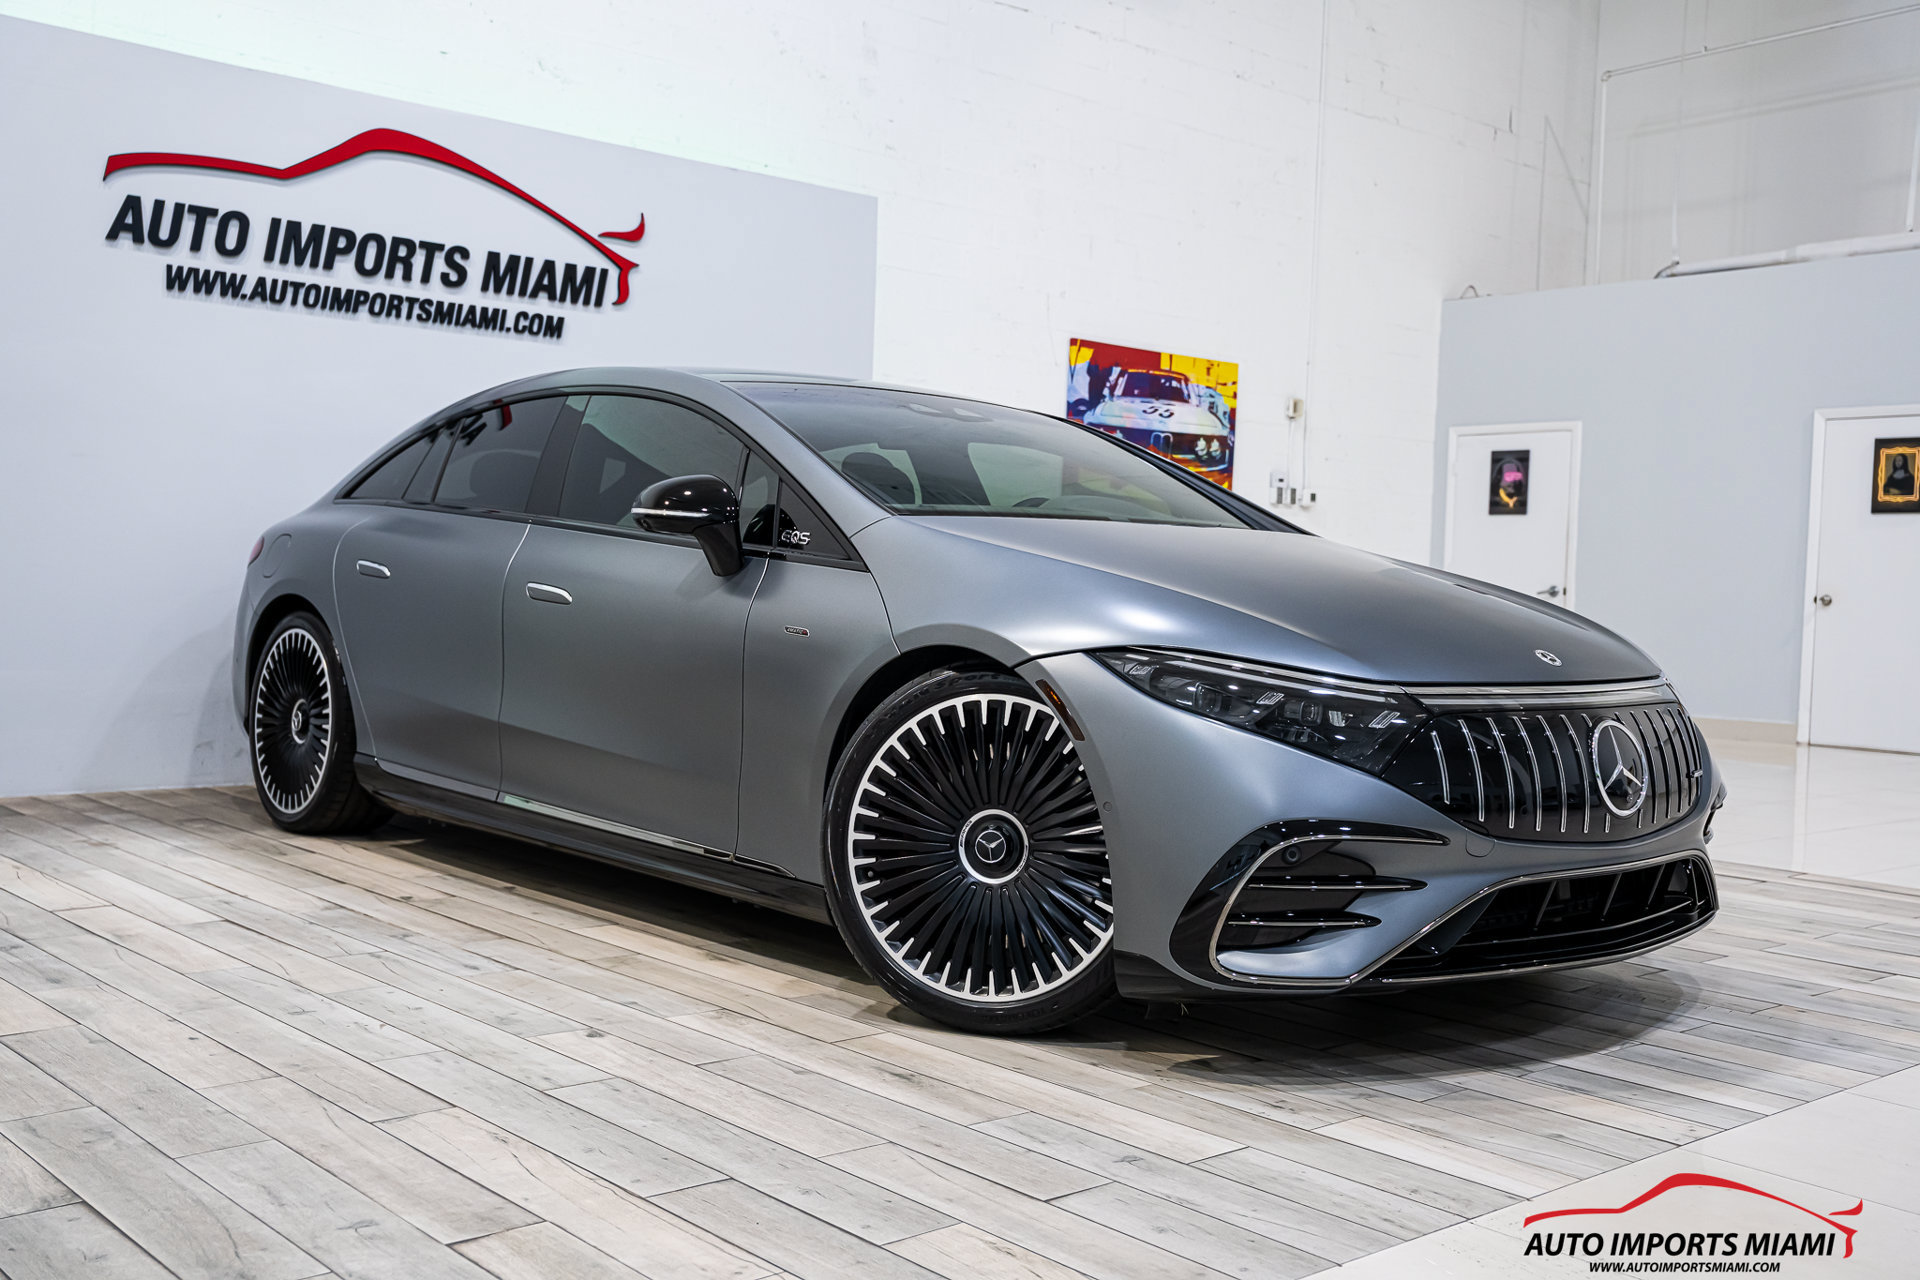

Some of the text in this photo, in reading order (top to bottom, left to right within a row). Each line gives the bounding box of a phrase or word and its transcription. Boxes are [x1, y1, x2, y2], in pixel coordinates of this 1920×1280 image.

[105, 194, 609, 308] AUTO IMPORTS MIAMI
[165, 263, 565, 340] WWW.AUTOIMPORTSMIAMI.COM
[781, 530, 811, 545] EQS
